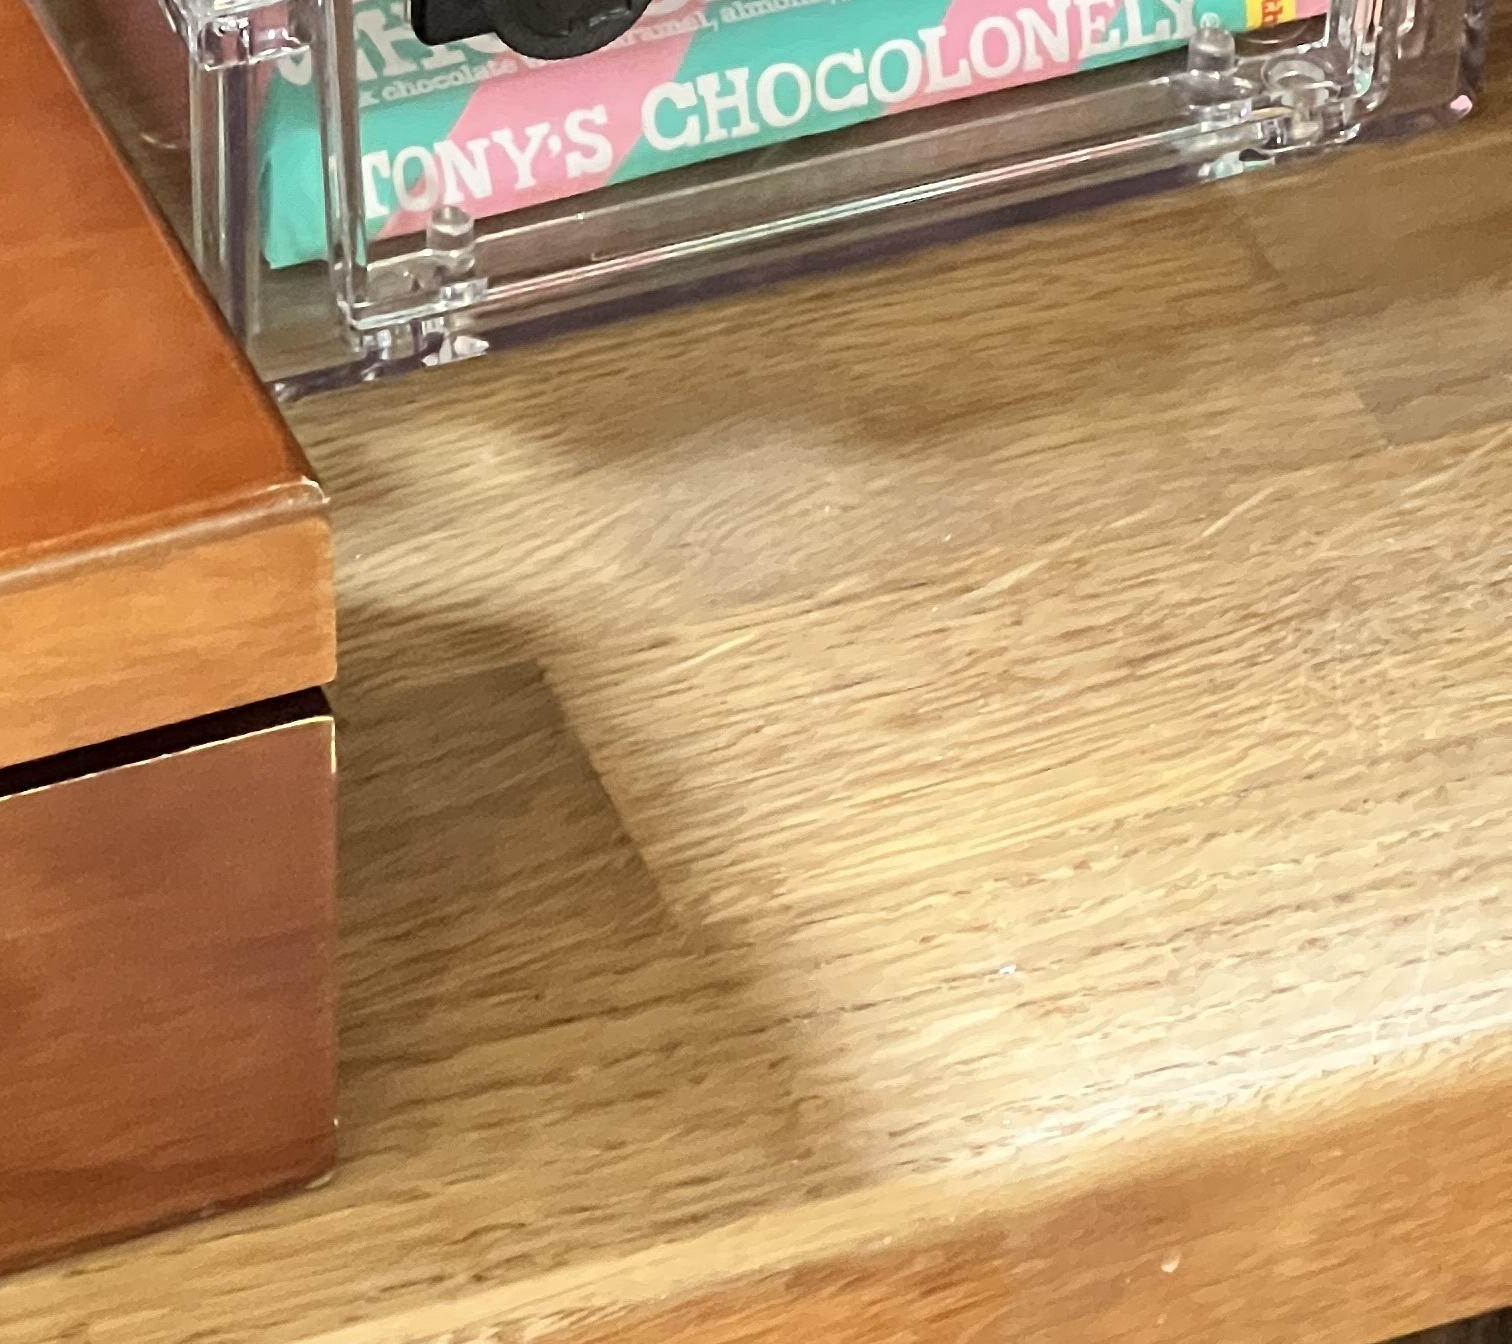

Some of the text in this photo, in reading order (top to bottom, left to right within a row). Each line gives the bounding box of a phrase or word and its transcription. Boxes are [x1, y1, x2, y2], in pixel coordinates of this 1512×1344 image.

[381, 58, 518, 102] chocolate
[601, 10, 720, 53] aramel,
[361, 103, 614, 220] TONY'S
